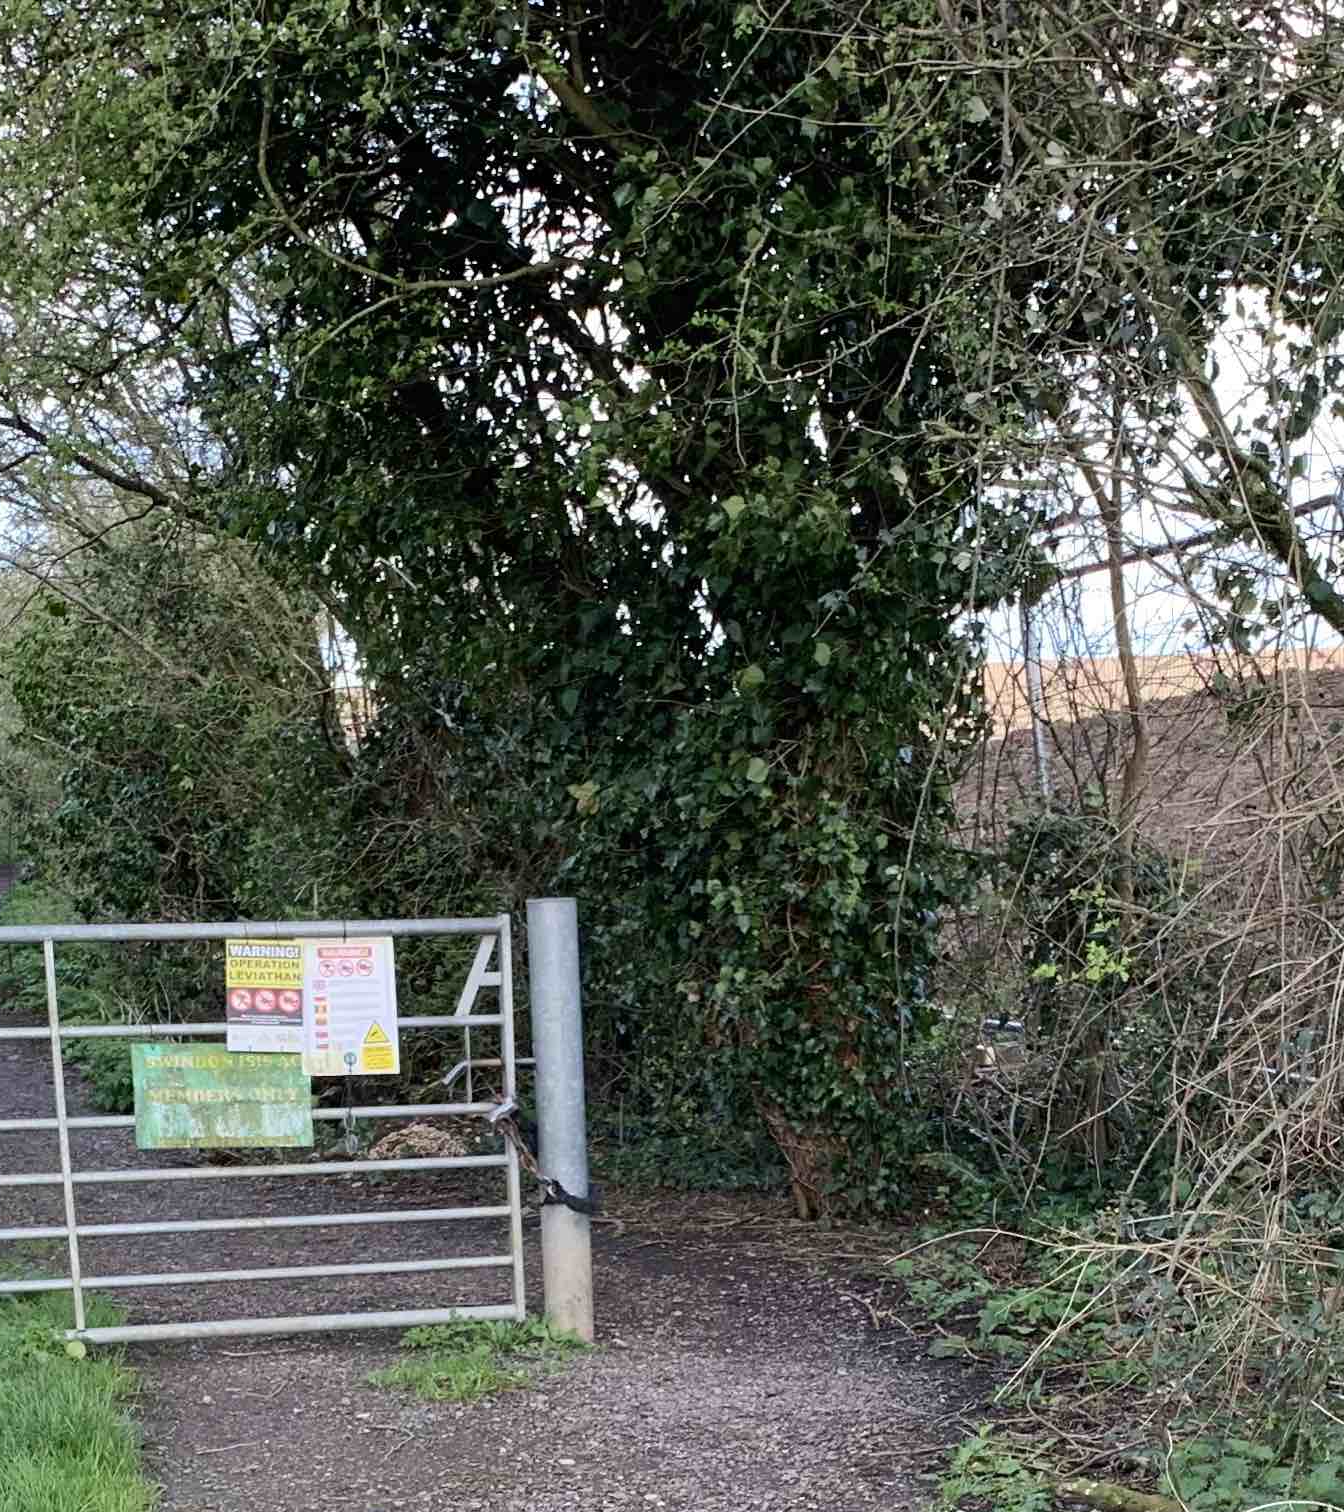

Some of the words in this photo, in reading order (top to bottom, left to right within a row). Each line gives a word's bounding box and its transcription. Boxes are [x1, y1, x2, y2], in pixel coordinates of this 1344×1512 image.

[229, 945, 299, 958] WARNING!
[229, 959, 300, 969] OPERATION
[229, 970, 302, 981] LEVIATHAN
